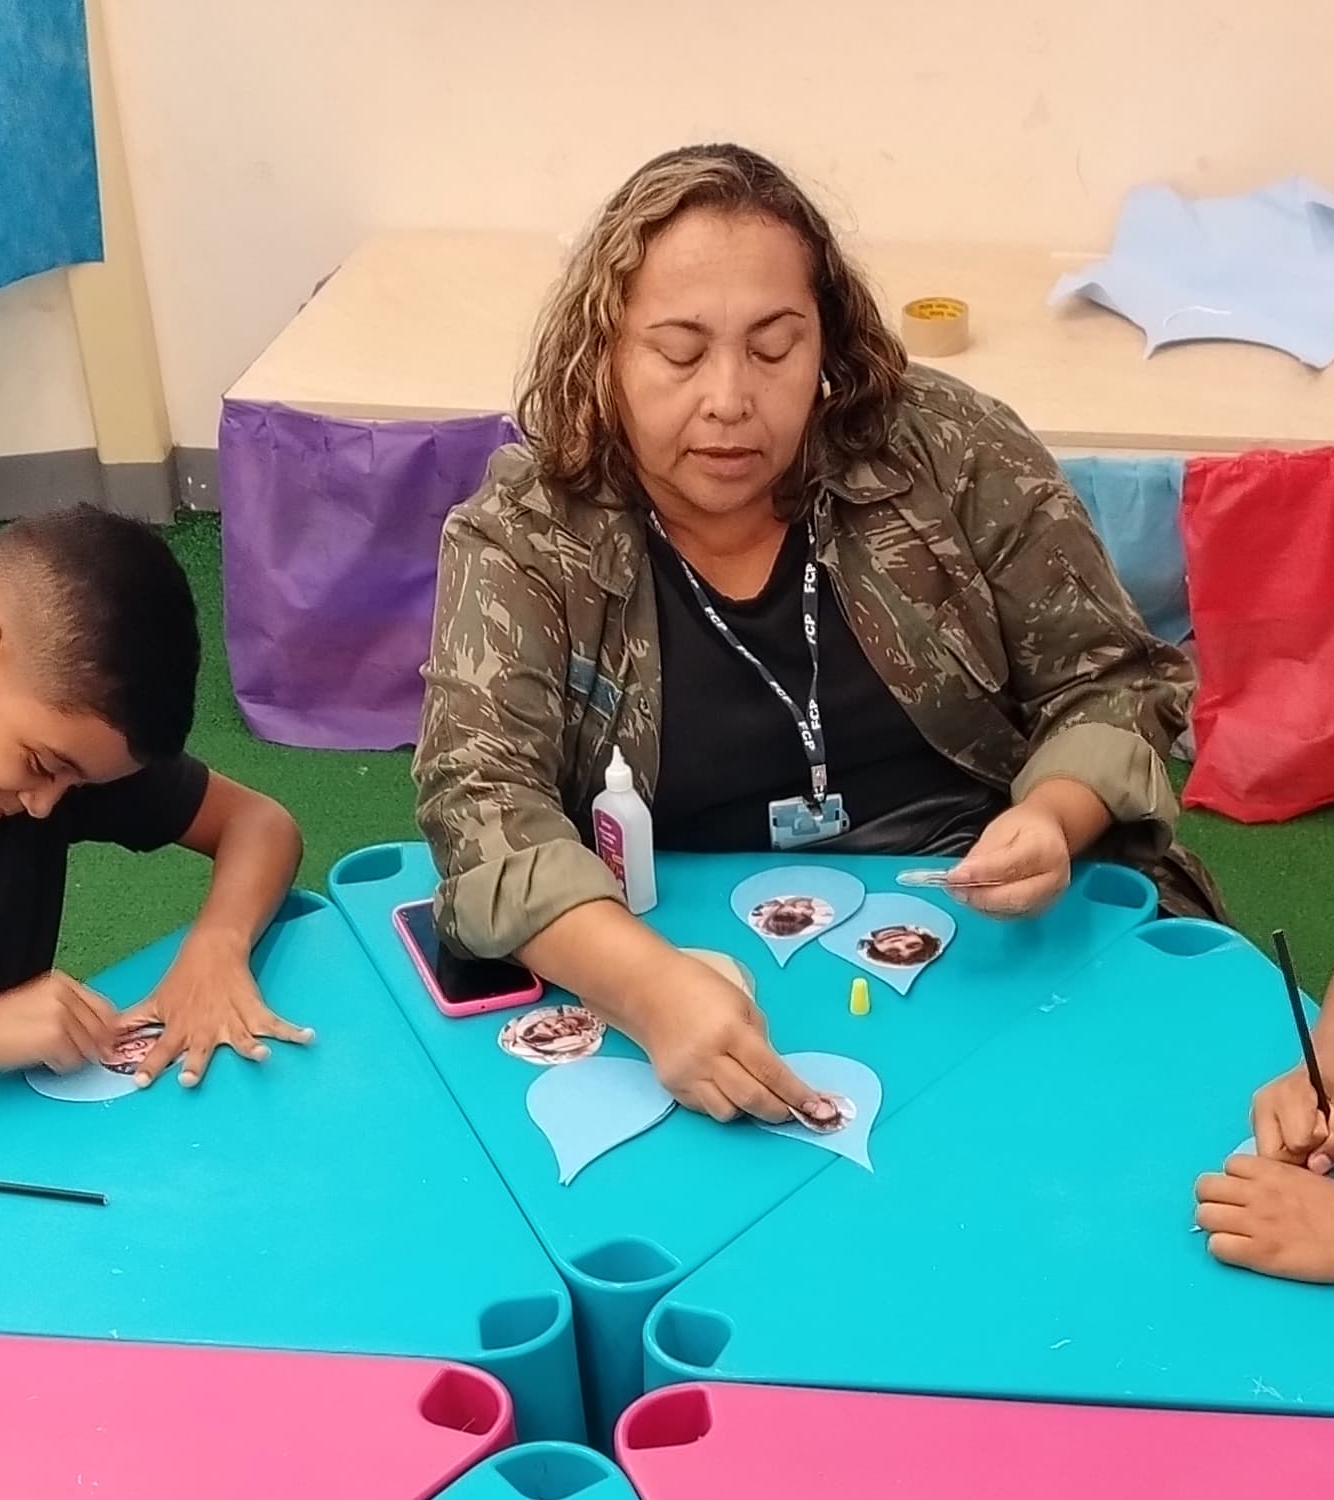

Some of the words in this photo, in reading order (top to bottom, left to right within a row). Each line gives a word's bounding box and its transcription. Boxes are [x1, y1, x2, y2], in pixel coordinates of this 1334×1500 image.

[803, 562, 817, 593] FCP
[808, 698, 822, 730] FCP
[797, 720, 816, 751] FCP
